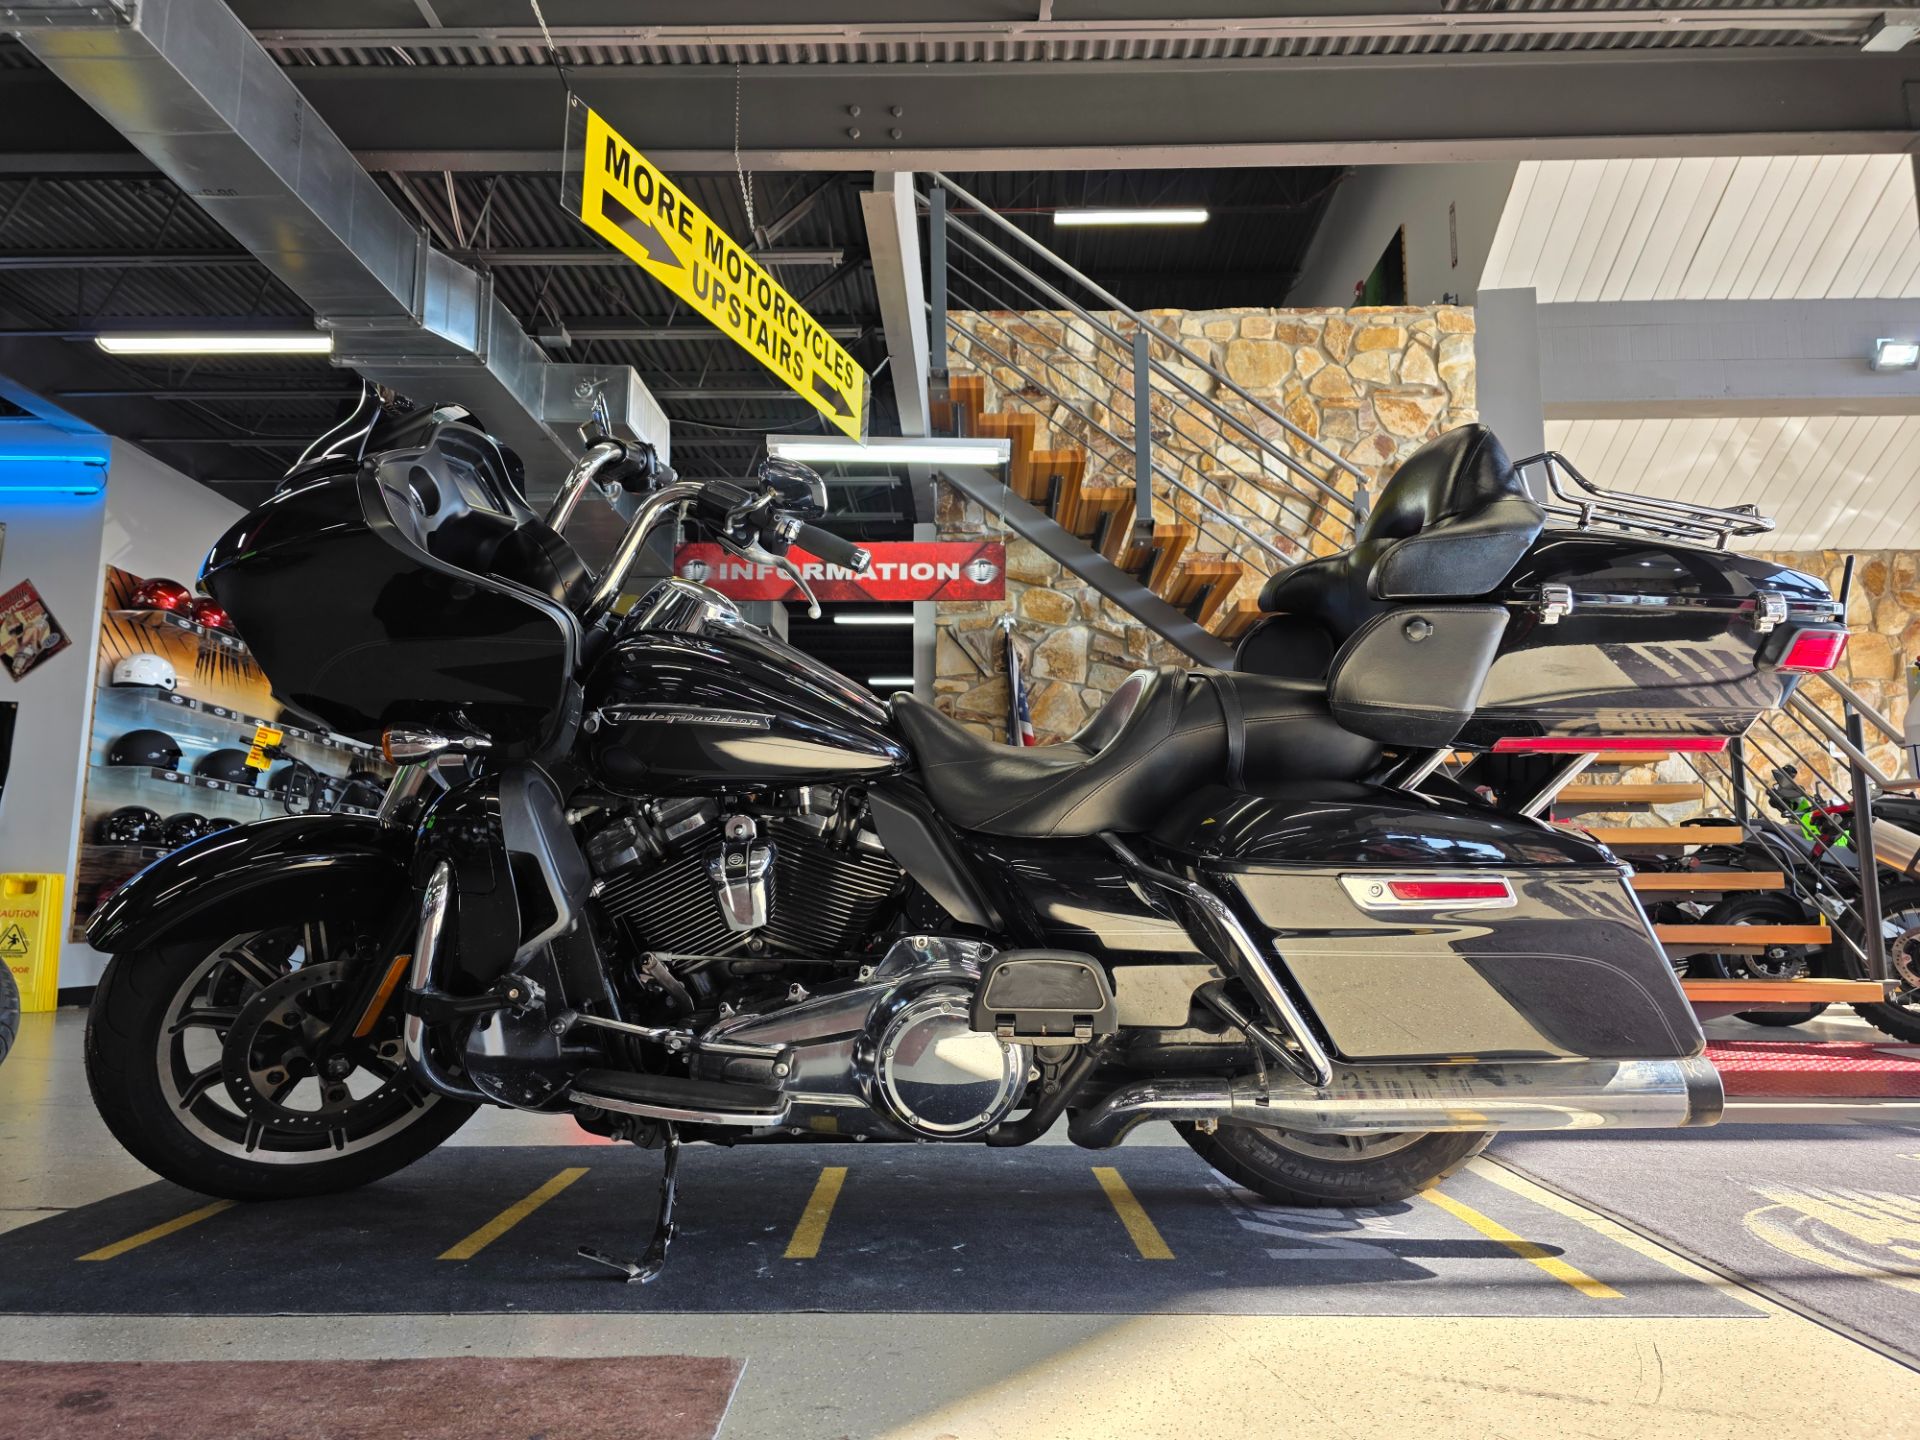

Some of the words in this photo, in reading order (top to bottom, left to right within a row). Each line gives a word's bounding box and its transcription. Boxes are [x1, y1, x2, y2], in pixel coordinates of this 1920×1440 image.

[604, 135, 694, 244] MORE
[705, 226, 854, 390] MOTORCYCLES
[692, 261, 804, 382] UPSTAIRS
[719, 562, 960, 580] INFORMATION
